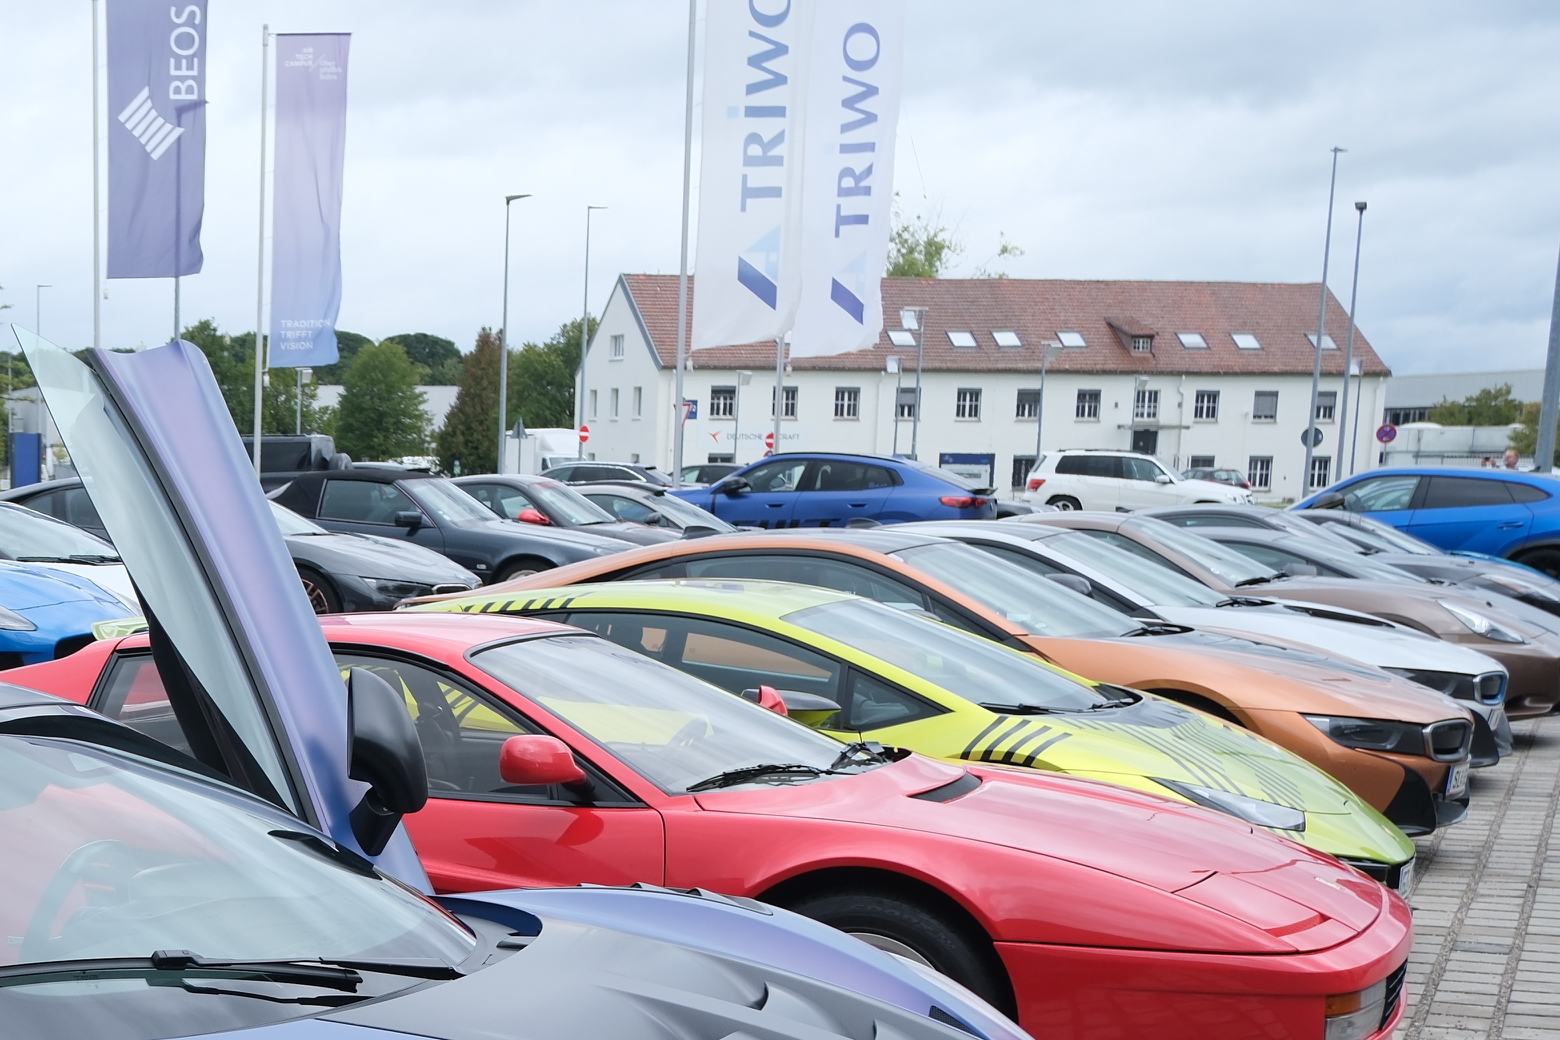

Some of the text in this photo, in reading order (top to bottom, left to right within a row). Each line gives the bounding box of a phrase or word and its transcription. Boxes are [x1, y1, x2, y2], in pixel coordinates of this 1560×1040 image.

[169, 4, 202, 101] BEOS
[834, 22, 881, 239] TRIWO
[281, 319, 331, 328] TRADITION
[280, 330, 313, 339] TRIFFT
[280, 341, 314, 350] VISION
